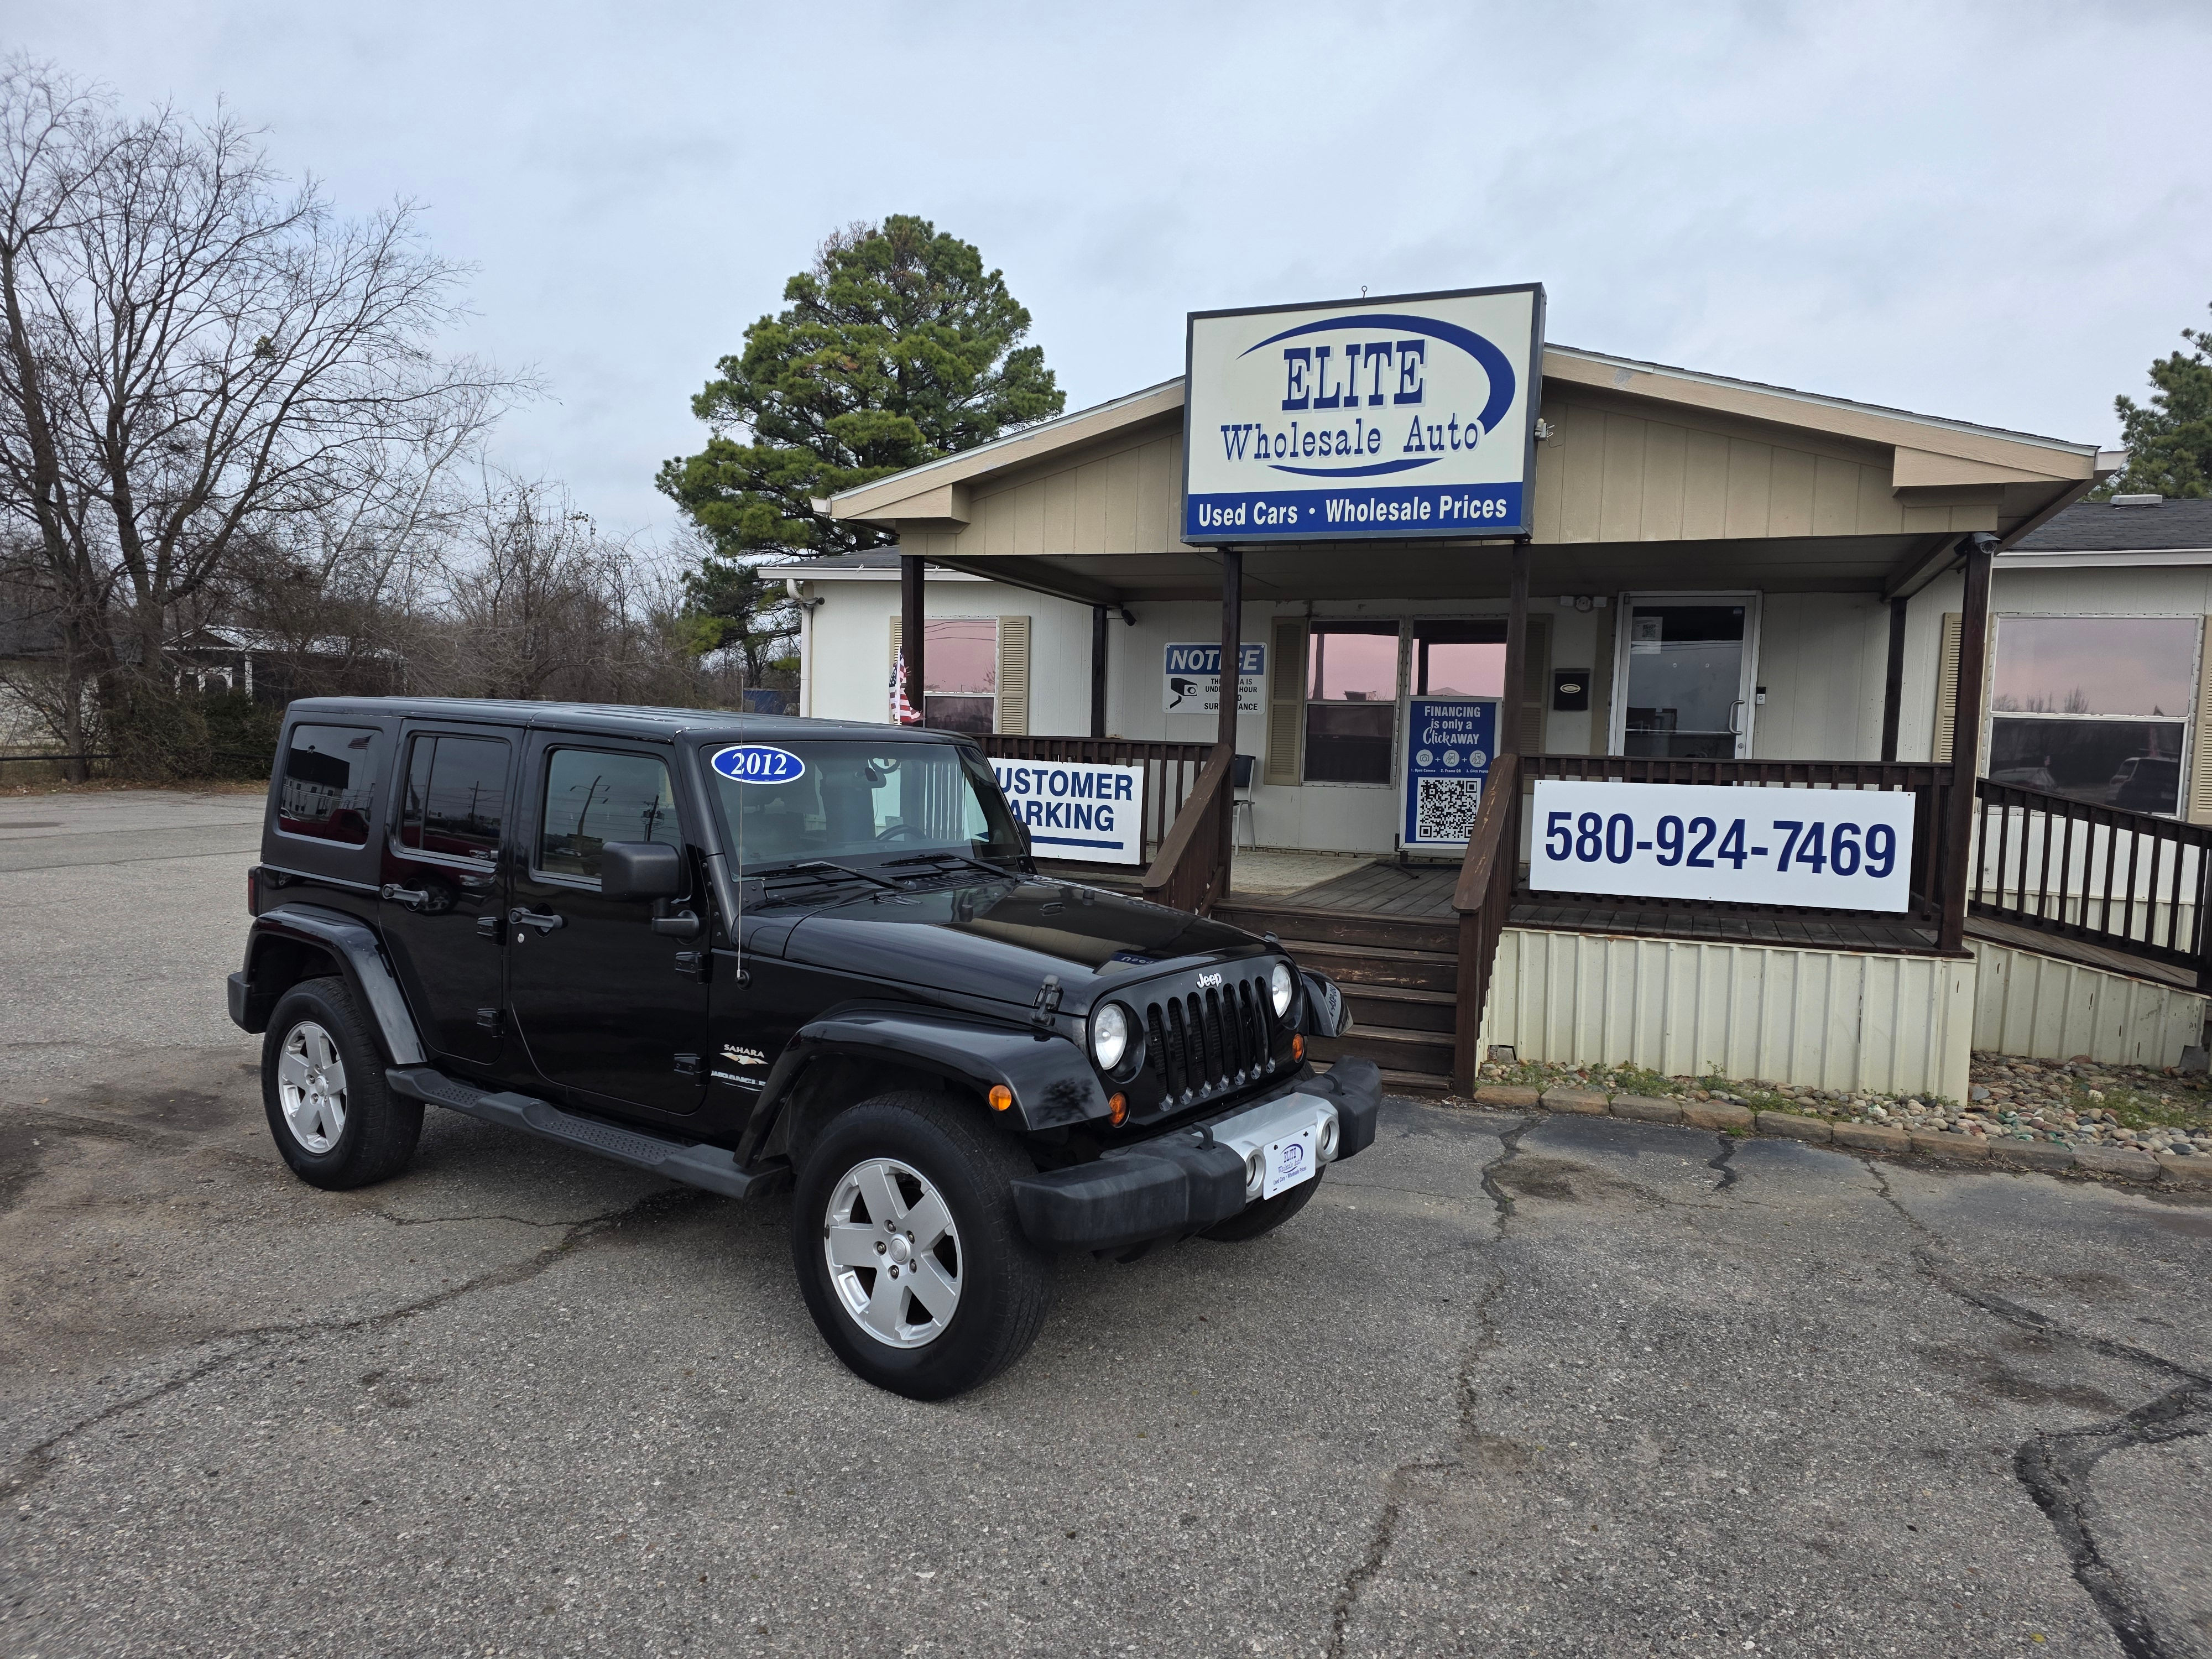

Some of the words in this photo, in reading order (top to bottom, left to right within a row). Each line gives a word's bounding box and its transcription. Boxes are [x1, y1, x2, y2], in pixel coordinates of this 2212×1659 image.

[1282, 339, 1427, 412] ELITE
[1220, 418, 1382, 461] Wholesale
[1403, 413, 1479, 453] Auto
[1199, 502, 1246, 526] Used
[1253, 501, 1298, 525] Cars
[1326, 495, 1431, 523] Wholesale
[1439, 494, 1507, 519] Prices
[1170, 650, 1260, 670] NOTE
[1204, 702, 1258, 711] SURANCE
[1425, 706, 1480, 717] FINANCING
[1431, 718, 1439, 729] is
[1442, 718, 1464, 732] only
[1465, 721, 1472, 729] a
[731, 753, 787, 775] 2012
[995, 767, 1133, 801] USTOMER
[1010, 799, 1114, 832] ARKING
[1545, 811, 1897, 878] 580-924-7469
[1196, 973, 1222, 988] Jeep
[724, 1044, 765, 1058] SAHARA
[711, 1070, 766, 1087] WRANGLE
[1284, 1147, 1297, 1163] ELITE
[1287, 1170, 1300, 1179] Wholesale
